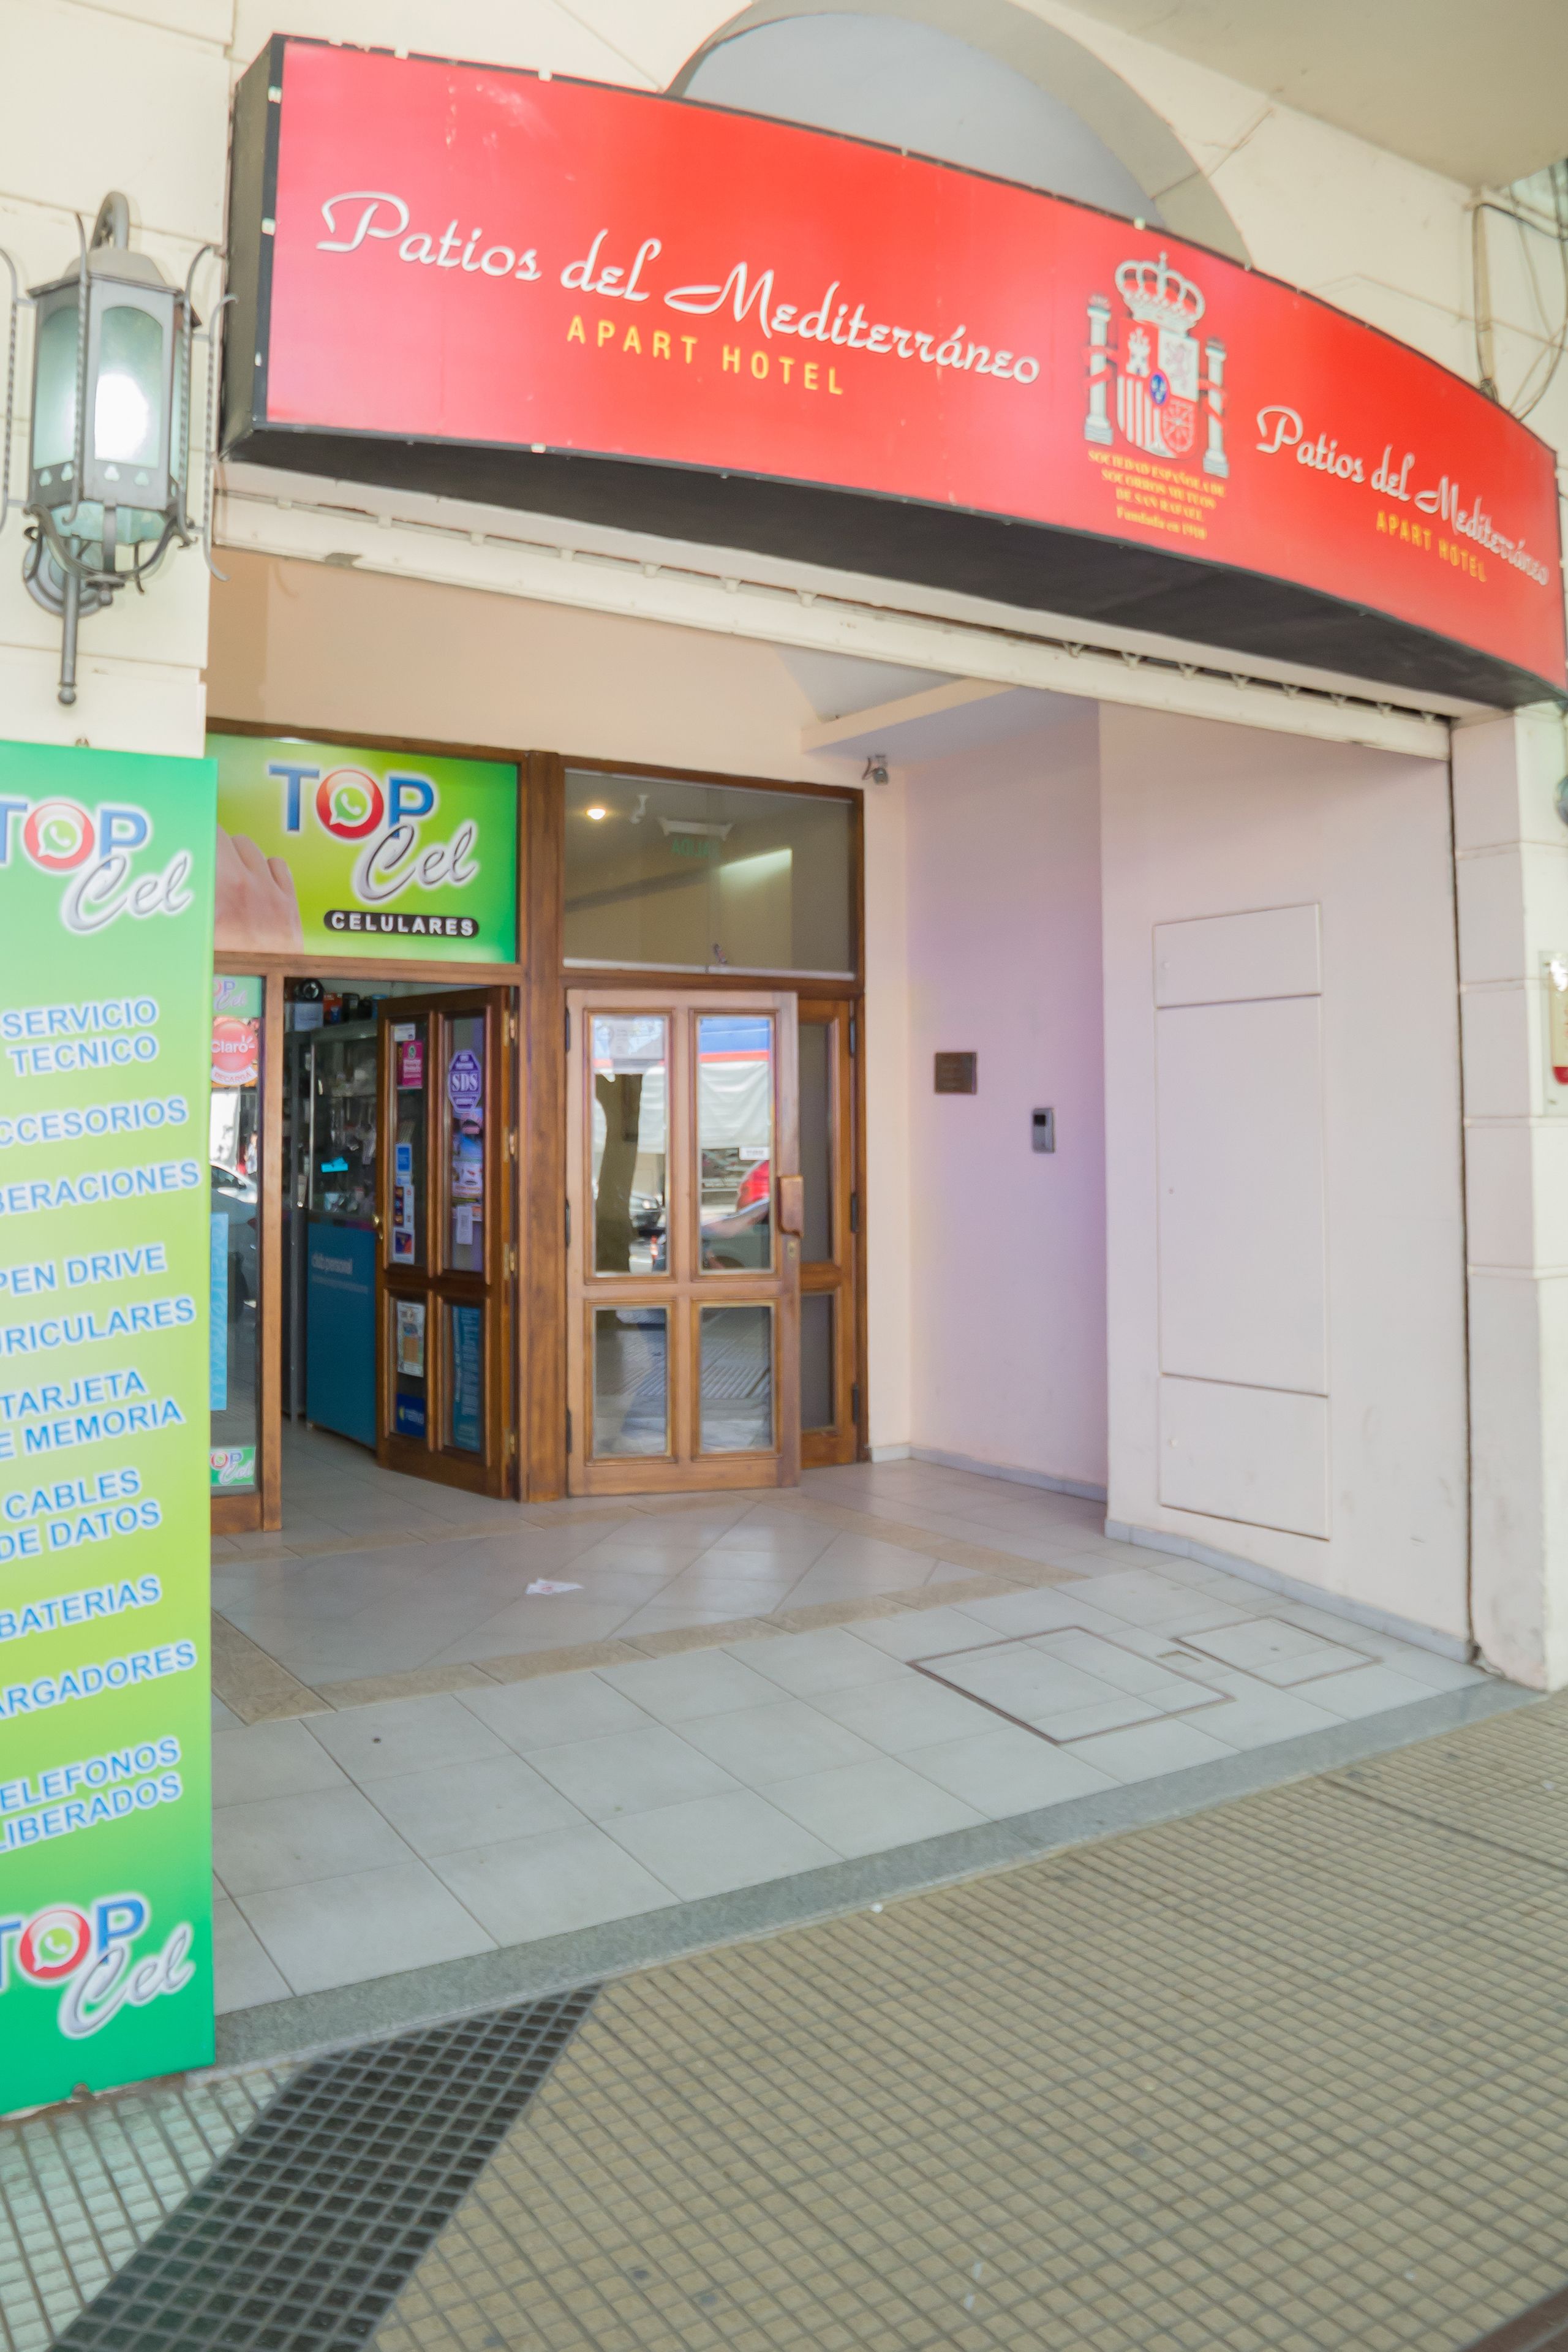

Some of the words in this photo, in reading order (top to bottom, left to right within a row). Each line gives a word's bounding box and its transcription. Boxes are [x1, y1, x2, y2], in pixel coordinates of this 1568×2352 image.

[315, 190, 543, 282] Patios
[560, 228, 662, 302] del
[664, 261, 1040, 384] Mediterráneo
[567, 315, 698, 364] APART
[722, 343, 843, 395] HOTEL
[1256, 405, 1366, 483] Patios
[1415, 475, 1550, 586] Mediterráneo
[1376, 510, 1433, 552] APART
[1438, 537, 1487, 583] HOTEL
[269, 764, 434, 839] TOP
[352, 822, 477, 902] Cel
[62, 853, 192, 932] Cel
[331, 911, 474, 937] CELULARES
[2, 1000, 157, 1038] SERVICIO
[10, 1035, 157, 1074] TECNICO
[452, 1072, 478, 1092] SDS
[0, 1162, 200, 1213] ERACIONES
[67, 1246, 165, 1285] DRIVE
[0, 1298, 194, 1355] RICULARES
[0, 1371, 146, 1420] TARJETA
[25, 1400, 183, 1453] MEMORIA
[5, 1469, 139, 1520] CABLES
[0, 1529, 40, 1560] DE
[50, 1501, 160, 1548] DATOS
[0, 1577, 160, 1640] BATERIAS
[0, 1643, 195, 1714] RGADORES
[59, 1924, 195, 2036] Cel
